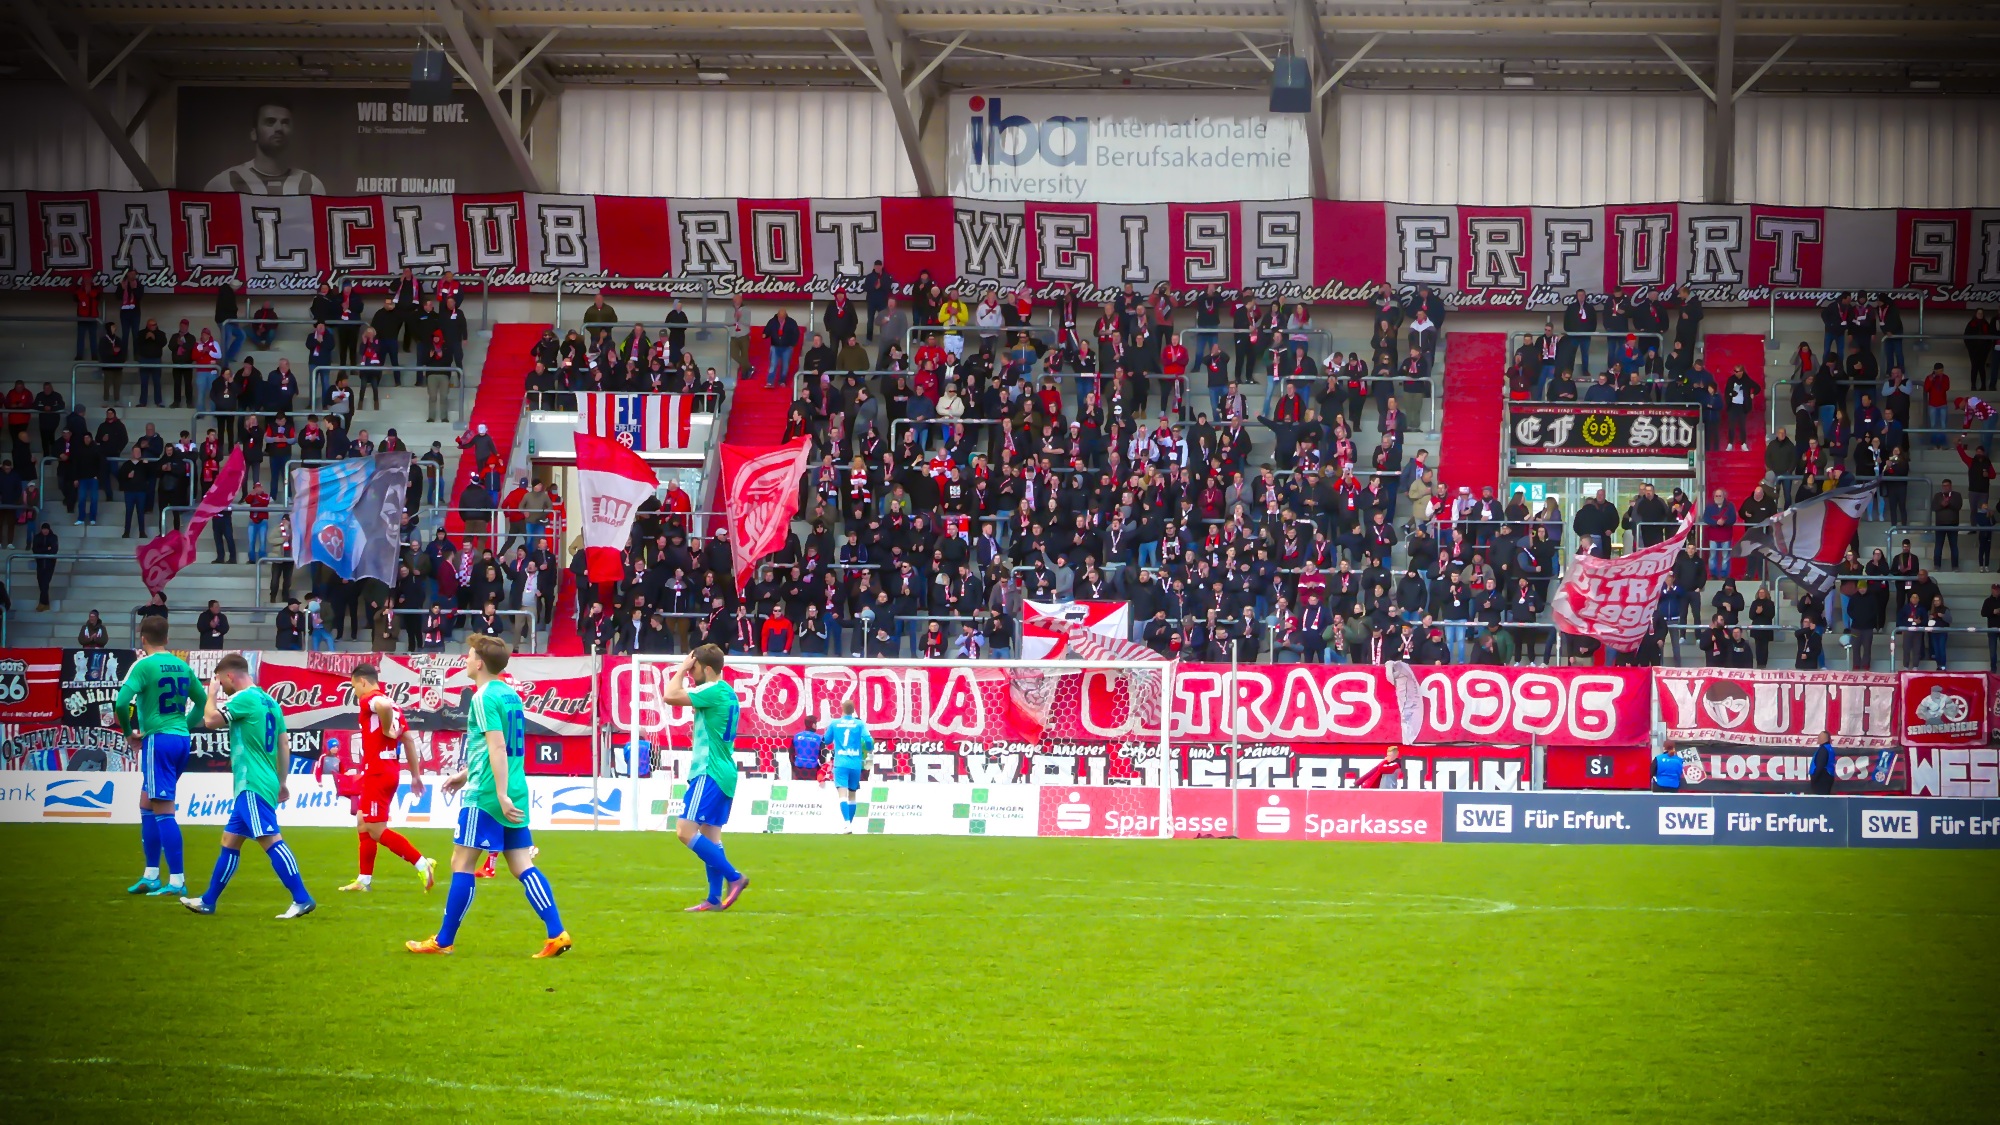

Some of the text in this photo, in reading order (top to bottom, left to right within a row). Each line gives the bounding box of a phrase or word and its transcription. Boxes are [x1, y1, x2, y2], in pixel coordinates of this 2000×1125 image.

[357, 102, 387, 122] WIR
[393, 102, 428, 122] SIND
[969, 95, 1088, 168] iba
[1096, 117, 1267, 140] Internationale
[1096, 145, 1292, 168] Berufsakademie
[356, 178, 397, 193] ALBERT
[969, 172, 1088, 204] University
[677, 208, 1301, 283] ROT-WEISS
[1396, 213, 1822, 289] ERFURT
[113, 267, 178, 288] drchs
[247, 275, 277, 290] wir
[279, 271, 321, 290] sind
[486, 267, 560, 290] bekannt
[803, 275, 828, 292] du
[1443, 286, 1487, 306] sind
[1490, 287, 1525, 307] wir
[1525, 284, 1562, 311] für
[1737, 283, 1770, 302] wir
[614, 393, 639, 425] FC
[614, 424, 642, 434] ERFURT
[1589, 422, 1609, 437] 98
[1628, 415, 1694, 448] Süd
[424, 669, 437, 678] FC
[1665, 667, 1890, 683] EFU EFU EFU ULTRAS EFU EFU EFU
[158, 676, 190, 715] 25
[1420, 669, 1625, 741] 1996
[265, 712, 277, 753] 8
[842, 728, 851, 747] 1
[1669, 730, 1887, 746] EFU EFU EFU ULTRAS EF EFU EFU
[1118, 742, 1179, 764] Erfole
[1189, 743, 1214, 760] und
[1711, 754, 1760, 780] LOS
[1304, 813, 1428, 838] Sparkasse
[1462, 809, 1506, 827] SWE
[1524, 809, 1631, 830] Für Erfurt.
[1664, 812, 1709, 830] SWE
[1727, 812, 1834, 833] Für Erfurt.
[1868, 815, 1912, 833] SWE
[1930, 815, 1966, 835] Für
